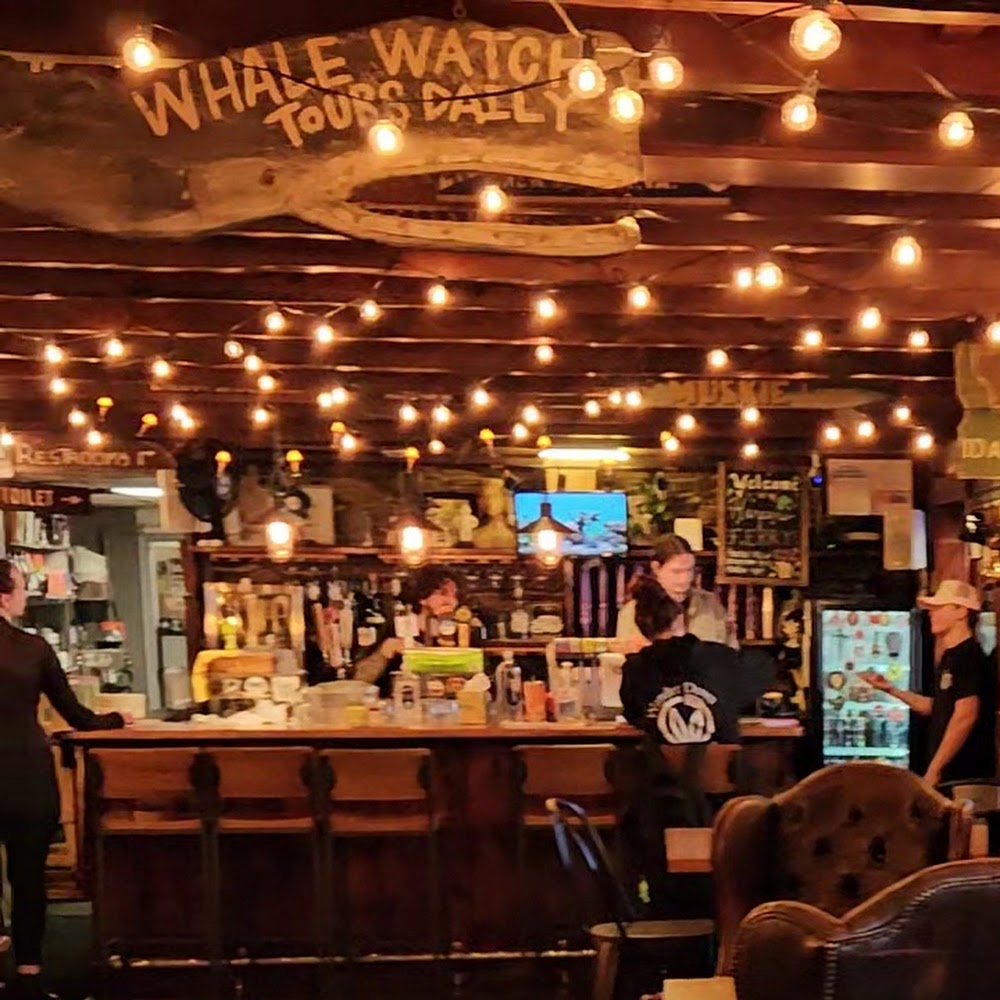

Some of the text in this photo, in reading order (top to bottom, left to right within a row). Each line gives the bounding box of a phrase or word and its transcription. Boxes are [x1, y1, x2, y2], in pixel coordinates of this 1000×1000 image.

[132, 26, 582, 136] WHALE WATCH
[262, 80, 576, 147] TOURS DAILY
